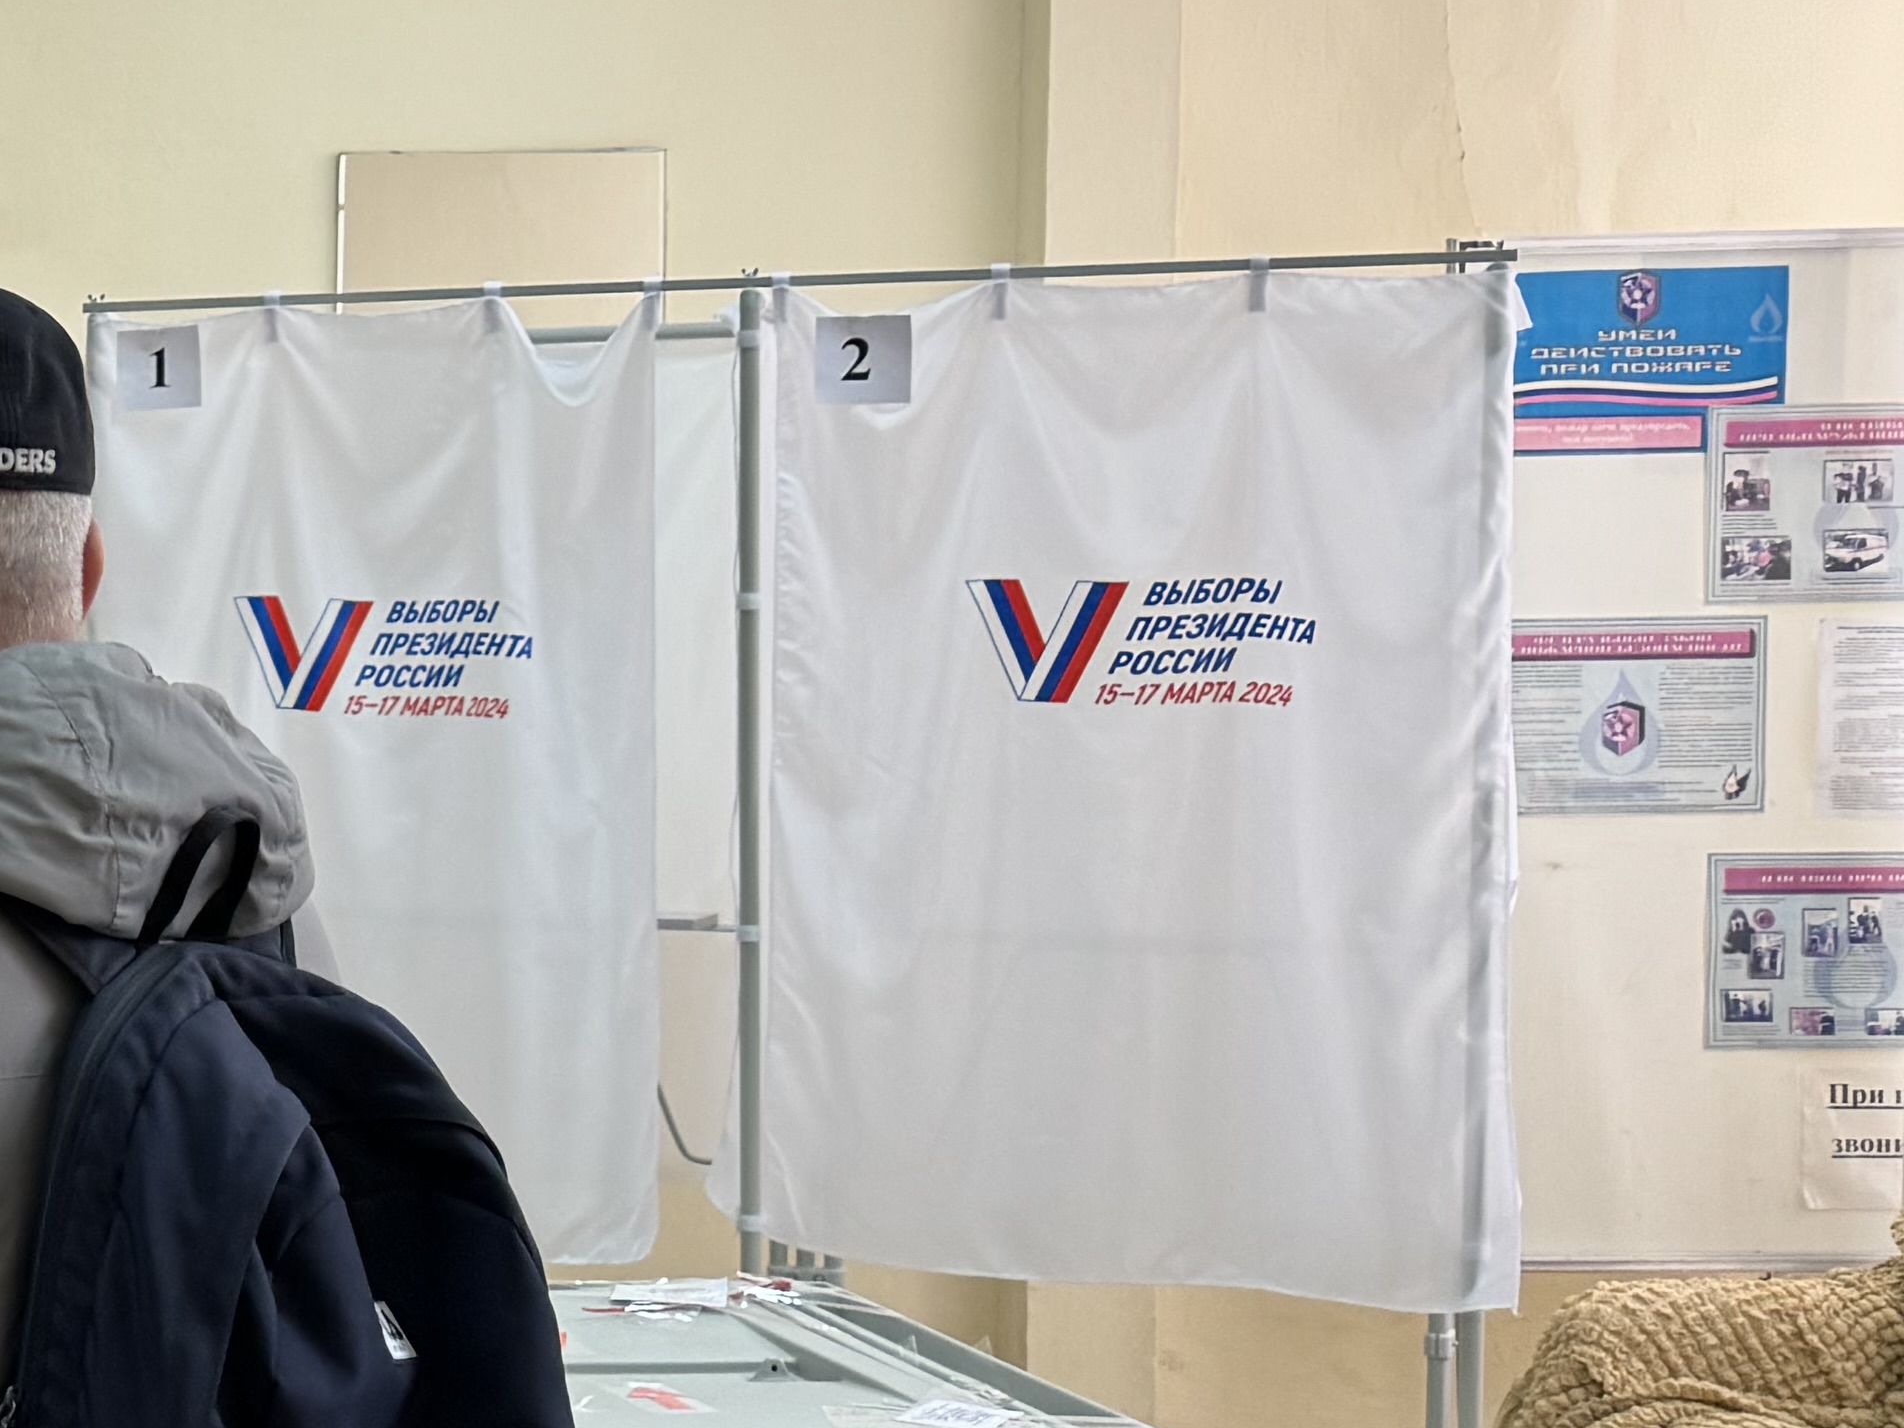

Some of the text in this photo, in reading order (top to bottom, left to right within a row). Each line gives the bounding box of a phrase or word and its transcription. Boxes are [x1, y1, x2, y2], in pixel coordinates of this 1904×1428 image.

[149, 347, 171, 389] 1
[841, 337, 871, 381] 2
[1142, 577, 1283, 607] ВЫБОРЫ
[386, 600, 500, 624] ВЫБОРЫ
[1125, 613, 1317, 645] ПРЕЗИДЕНТА
[370, 632, 534, 660] ПРЕЗИДЕНТА
[1108, 647, 1238, 675] РОССИИ
[354, 664, 465, 687] РОССИИ
[399, 696, 464, 717] МАРТА
[466, 697, 510, 719] 2024
[1161, 682, 1237, 705] МАРТА
[1238, 681, 1293, 707] 2024
[1829, 1083, 1884, 1107] При
